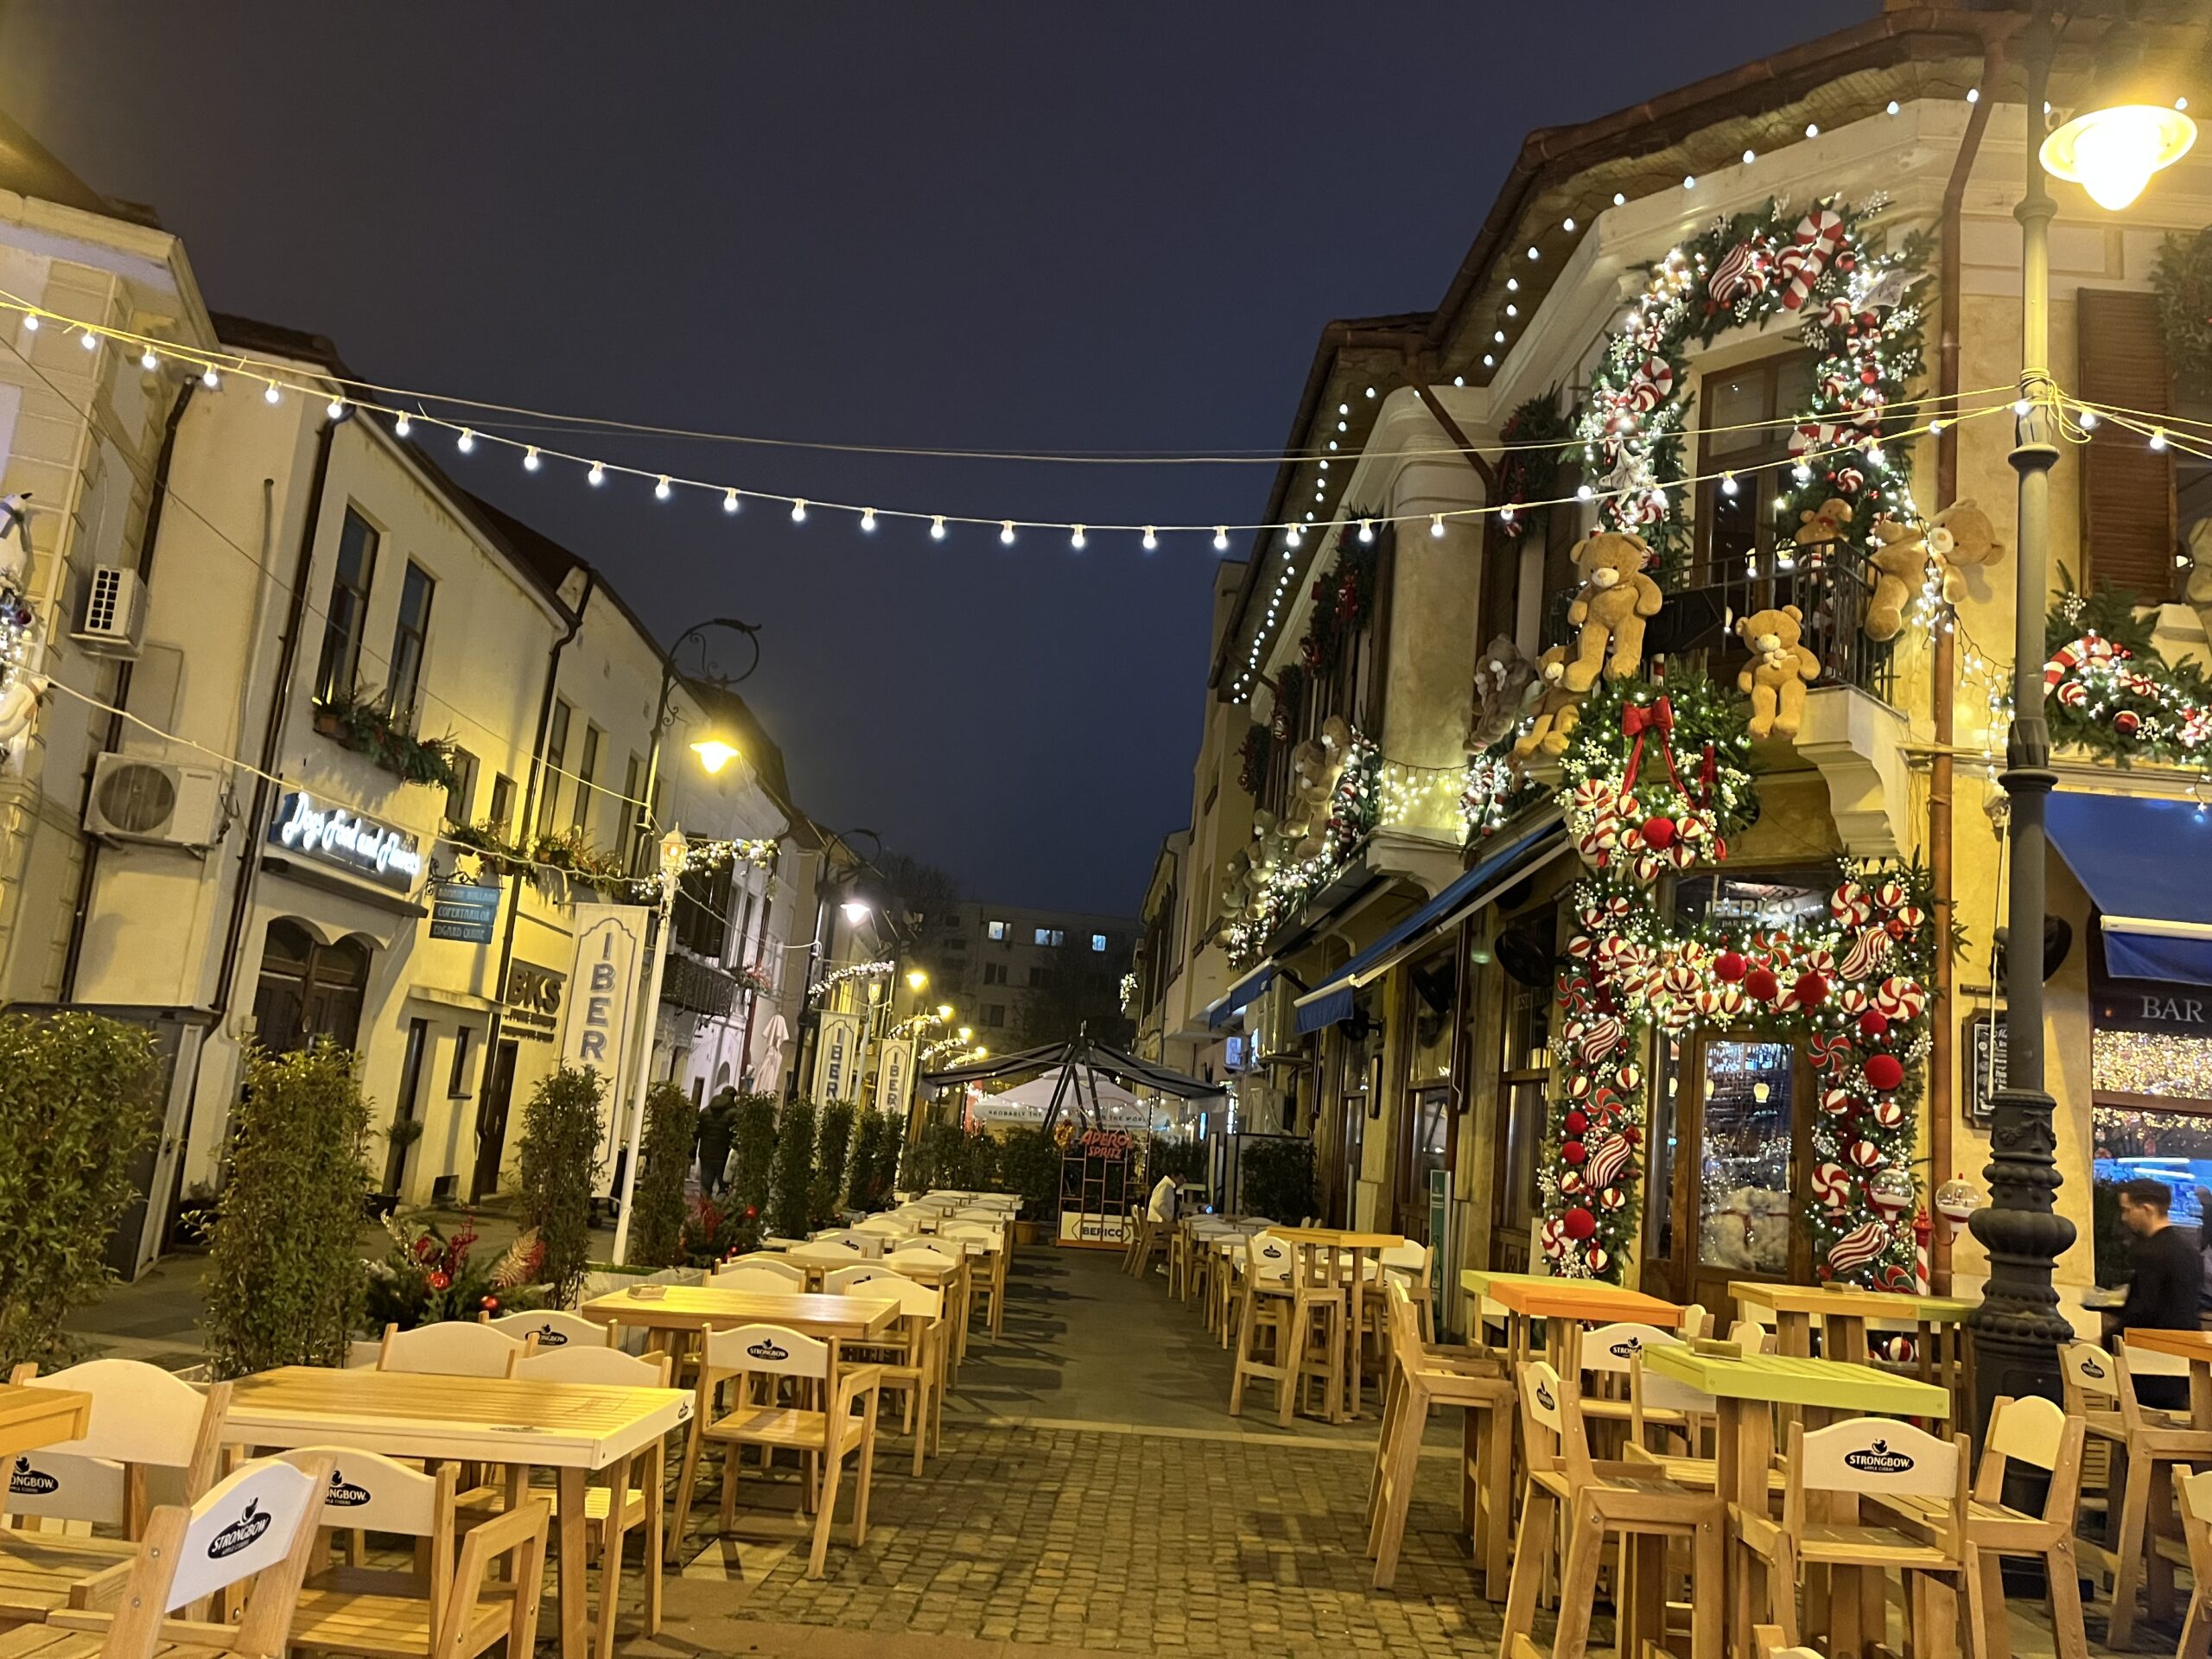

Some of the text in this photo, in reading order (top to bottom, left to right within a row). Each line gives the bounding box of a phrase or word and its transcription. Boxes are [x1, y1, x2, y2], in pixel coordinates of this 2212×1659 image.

[506, 964, 562, 1015] BKS
[580, 931, 616, 1062] IBER
[2140, 995, 2206, 1023] BAR
[1079, 1128, 1134, 1149] APEROL
[1088, 1146, 1122, 1159] SPRITZ
[1849, 1454, 1910, 1468] STRONGBOW
[11, 1475, 54, 1489] ONGBOW
[329, 1488, 366, 1501] NGBOW
[211, 1516, 270, 1553] STRONGBOW
